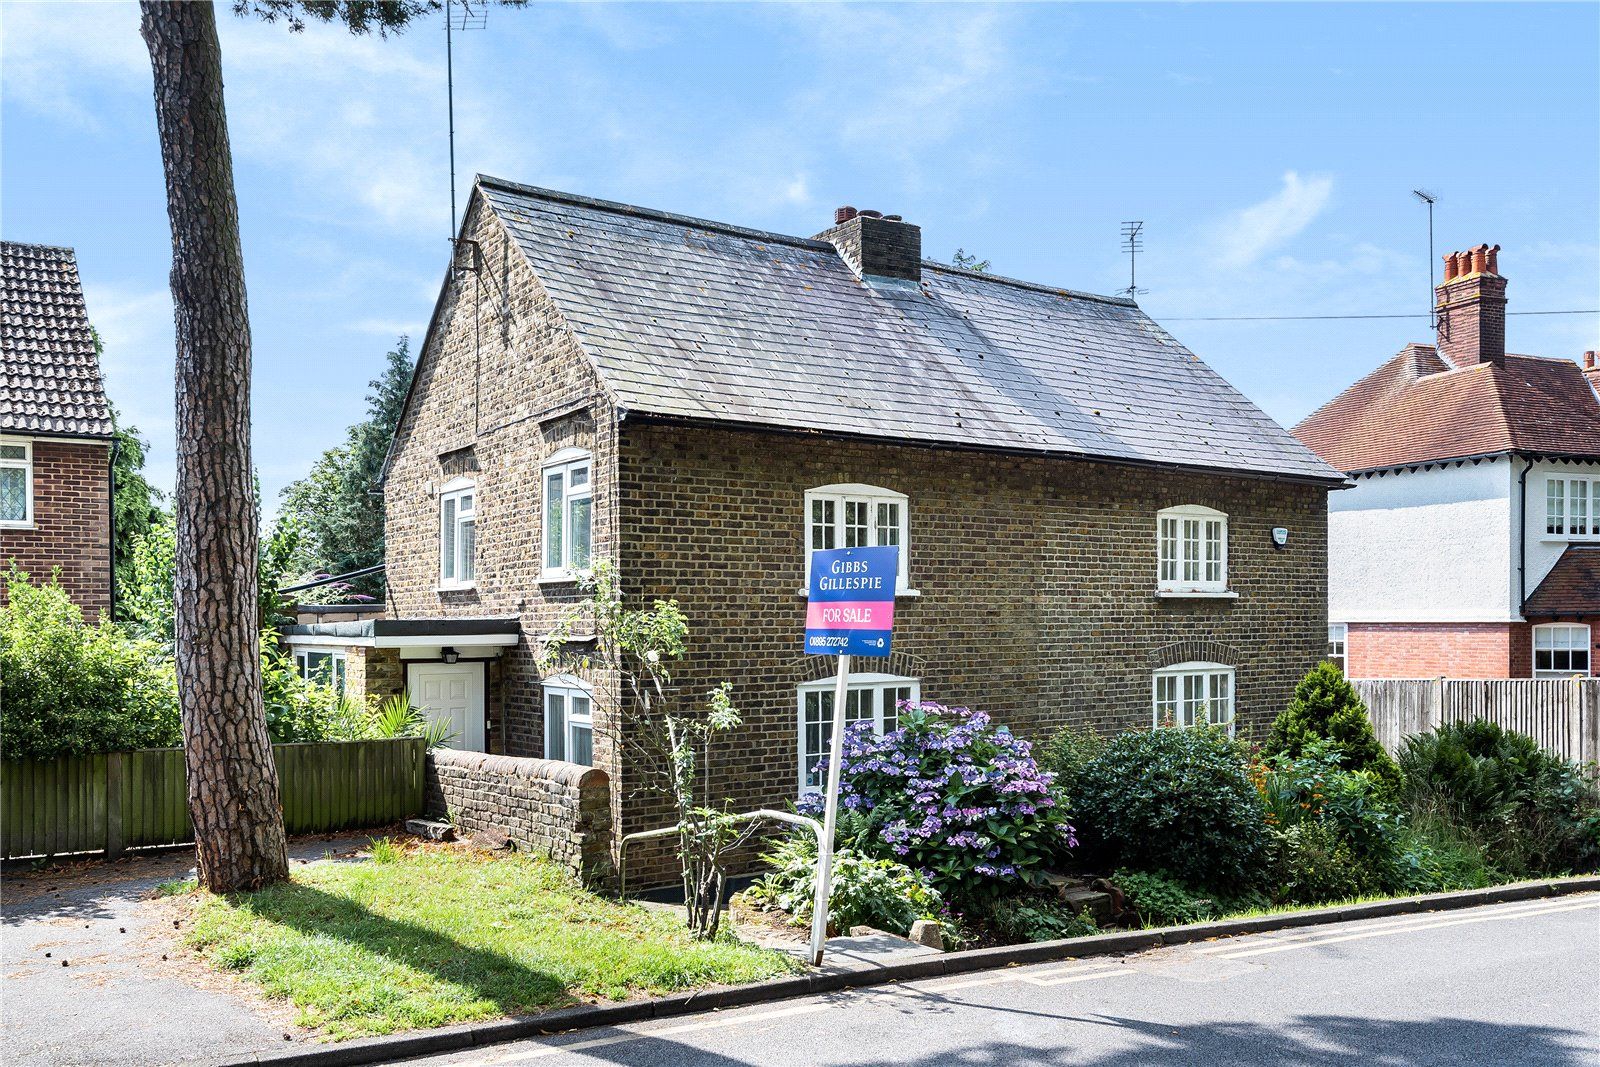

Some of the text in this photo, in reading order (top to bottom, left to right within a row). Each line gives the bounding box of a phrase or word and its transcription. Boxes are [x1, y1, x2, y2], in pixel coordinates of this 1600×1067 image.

[831, 560, 868, 574] GIBBS
[819, 576, 882, 590] GILLESPIE
[822, 608, 872, 623] FOR SALE
